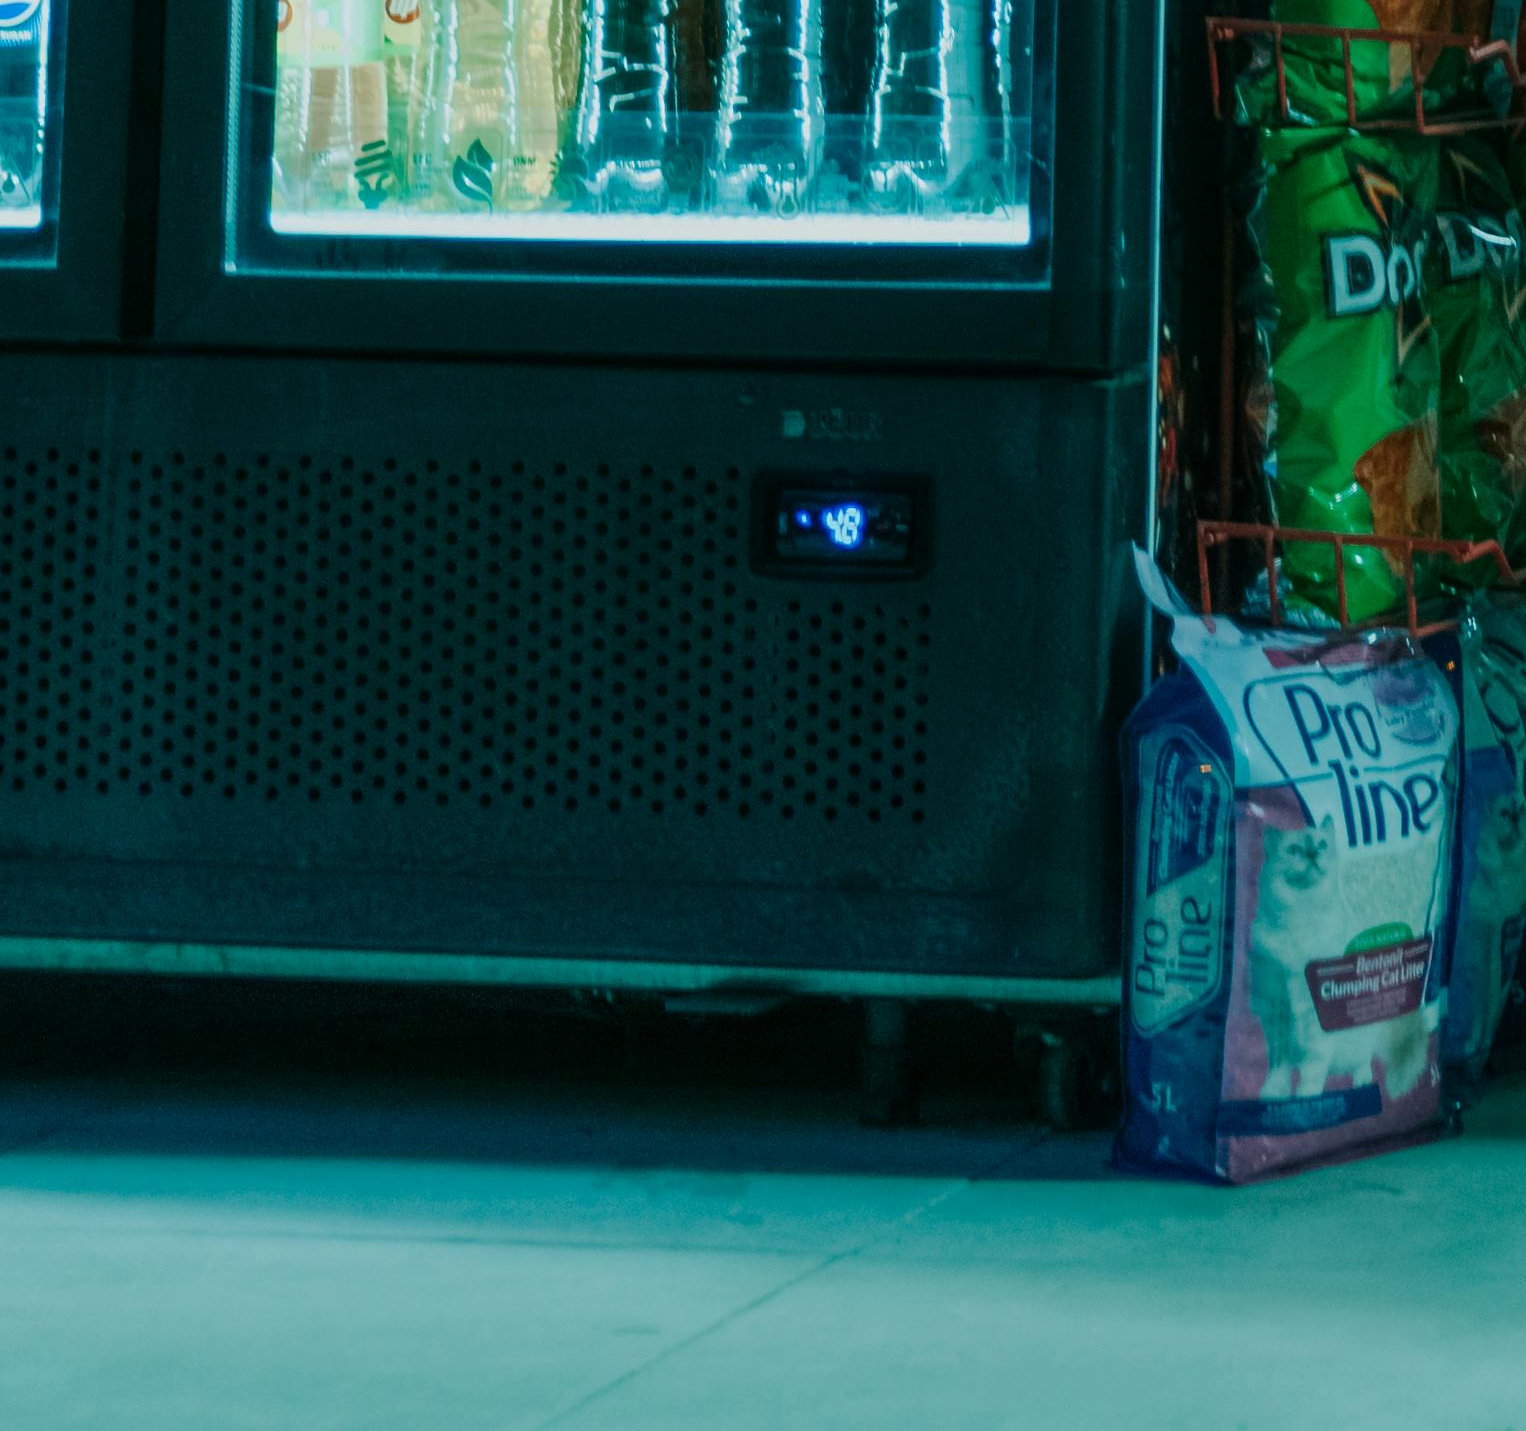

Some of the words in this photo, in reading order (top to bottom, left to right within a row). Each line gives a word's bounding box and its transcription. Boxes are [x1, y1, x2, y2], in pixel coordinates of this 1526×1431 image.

[1283, 683, 1383, 766] Pro
[1327, 759, 1440, 848] line
[1135, 919, 1168, 999] Pro
[1164, 895, 1213, 985] line
[1320, 976, 1380, 1000] Clumping
[1380, 970, 1400, 989] Cat
